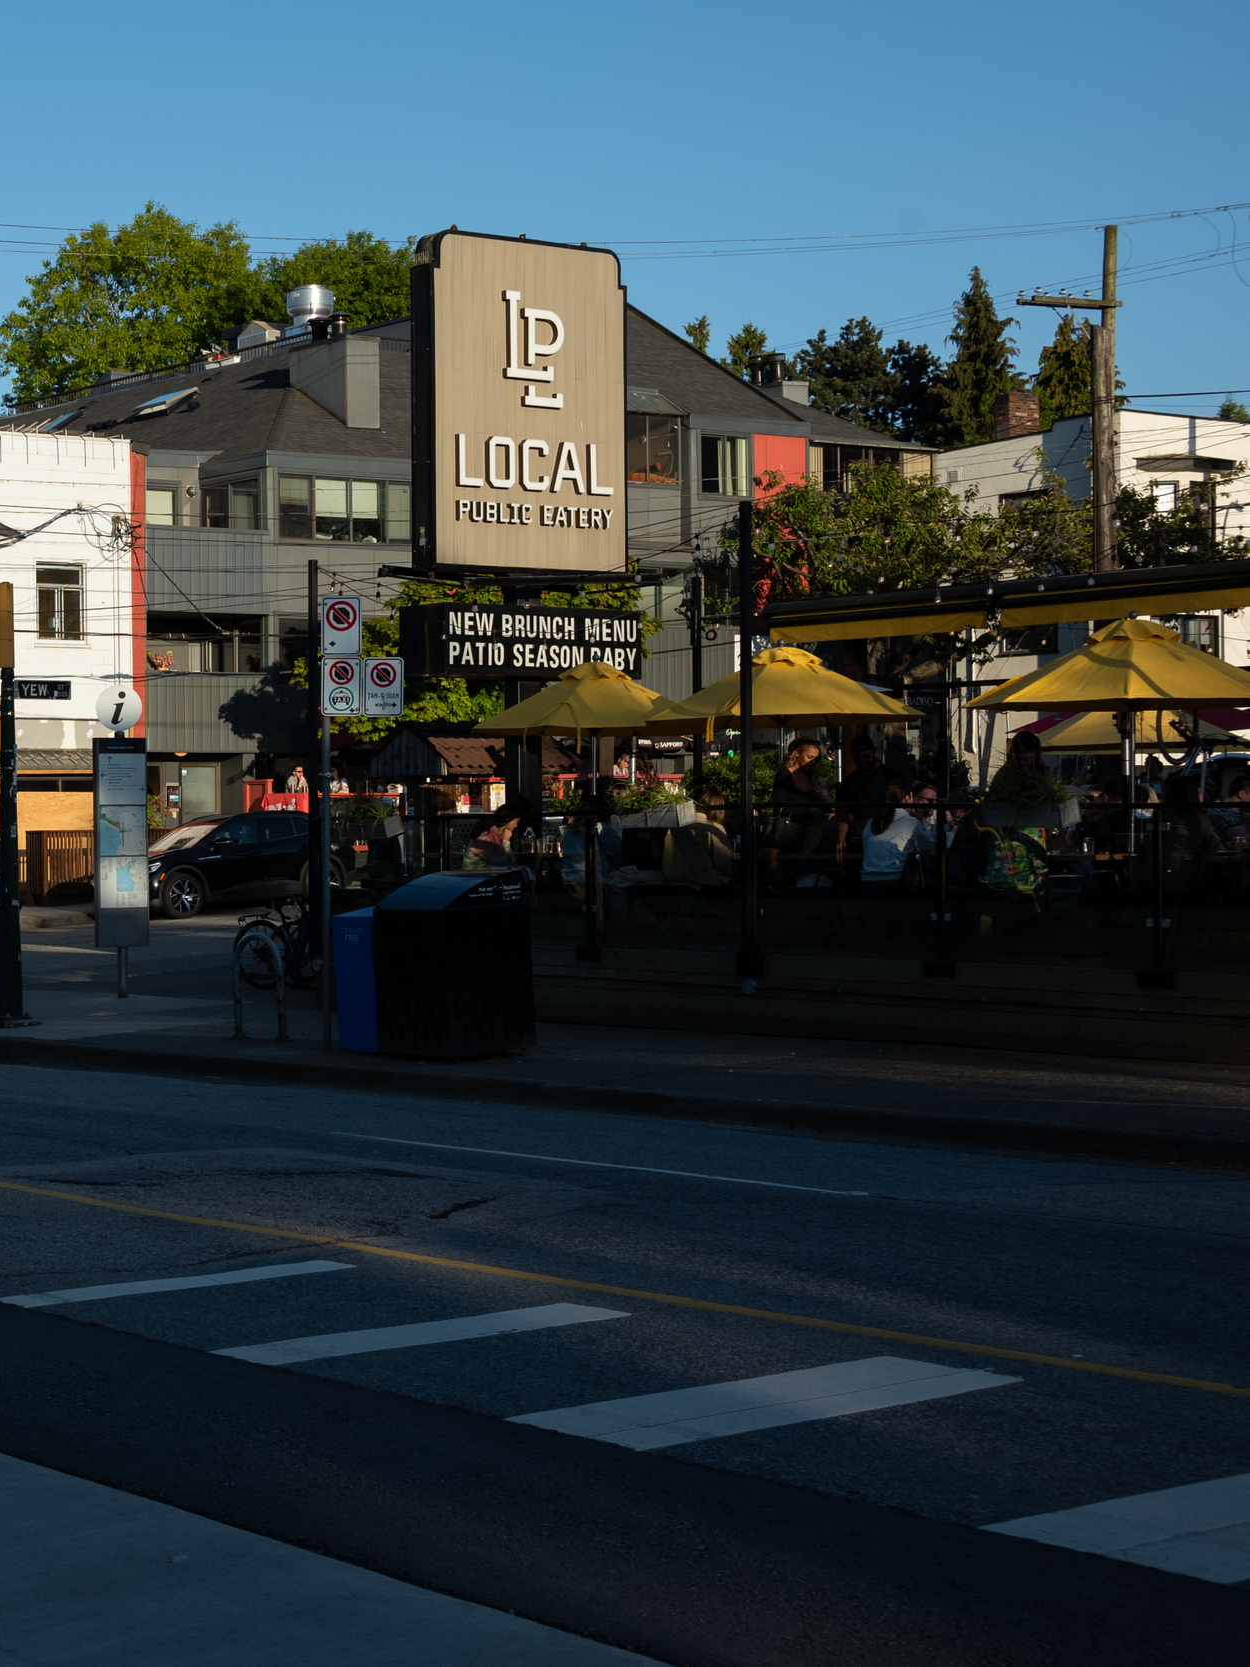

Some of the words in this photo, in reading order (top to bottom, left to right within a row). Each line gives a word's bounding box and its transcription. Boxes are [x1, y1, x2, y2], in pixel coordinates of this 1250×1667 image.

[456, 433, 614, 495] LOCAL
[457, 499, 533, 525] PUBLIC
[541, 504, 614, 529] EATERY
[448, 611, 495, 637] NEW
[501, 613, 575, 641] BRUNCH
[584, 617, 637, 643] MENU
[448, 641, 505, 666] PATIO
[513, 643, 584, 669] SEASON
[21, 683, 48, 697] YEW
[344, 933, 360, 942] FREE
